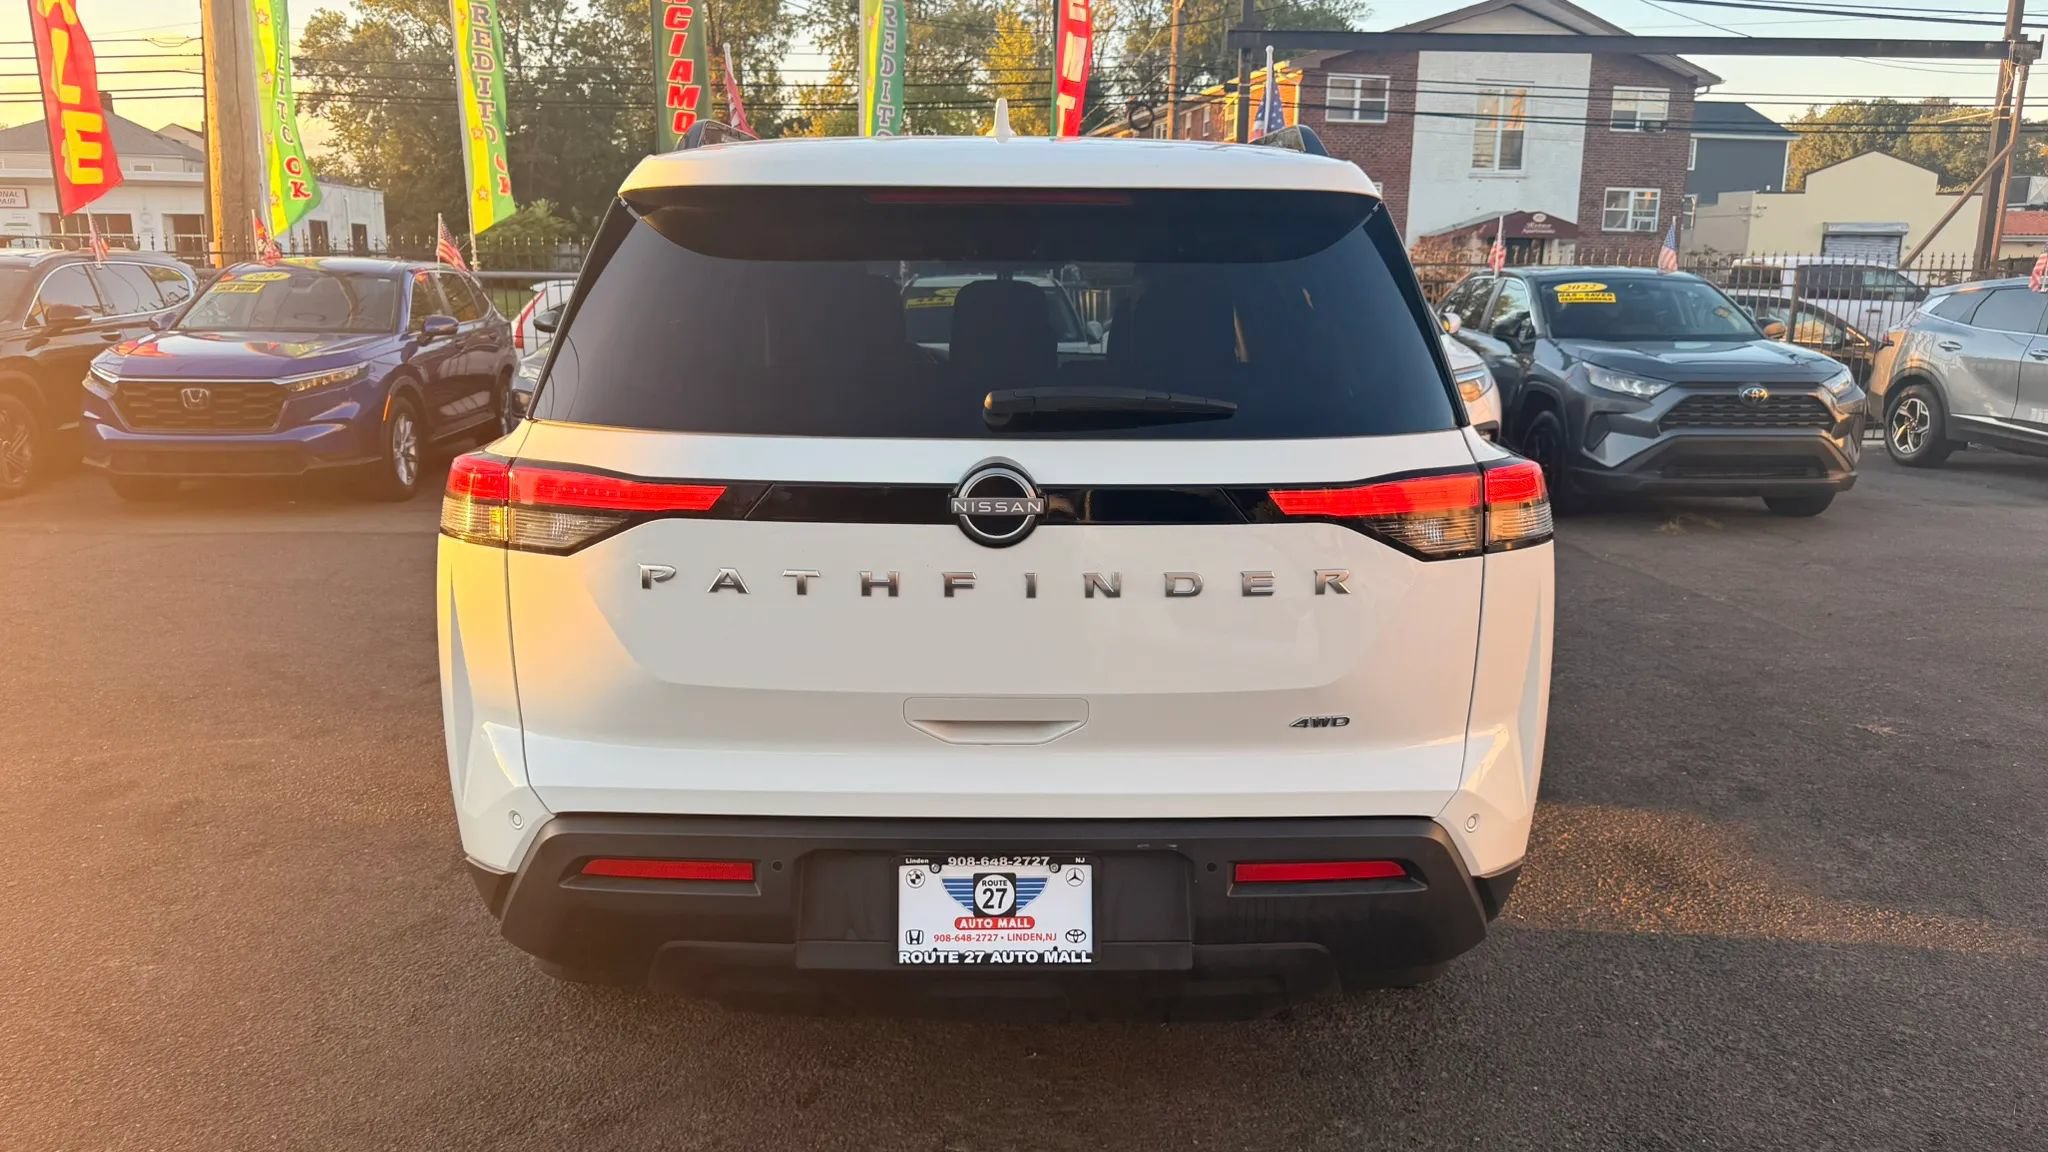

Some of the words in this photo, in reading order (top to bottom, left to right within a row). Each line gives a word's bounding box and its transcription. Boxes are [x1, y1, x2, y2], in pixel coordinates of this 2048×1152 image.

[663, 0, 702, 134] CIAMO
[285, 157, 311, 199] OK
[953, 501, 1041, 513] NISSAN
[638, 563, 1351, 598] PATHFINDER
[1289, 716, 1350, 728] 4WD
[948, 856, 1050, 867] 908-648-2727
[982, 879, 1008, 887] ROUTE
[982, 888, 1008, 910] 27
[959, 918, 993, 929] AUTO
[997, 918, 1031, 929] MALL
[933, 934, 998, 942] 908-648-2727
[899, 951, 959, 964] ROUTE
[963, 951, 985, 964] 27
[990, 951, 1039, 964] AUTO
[1044, 951, 1092, 964] MALL
